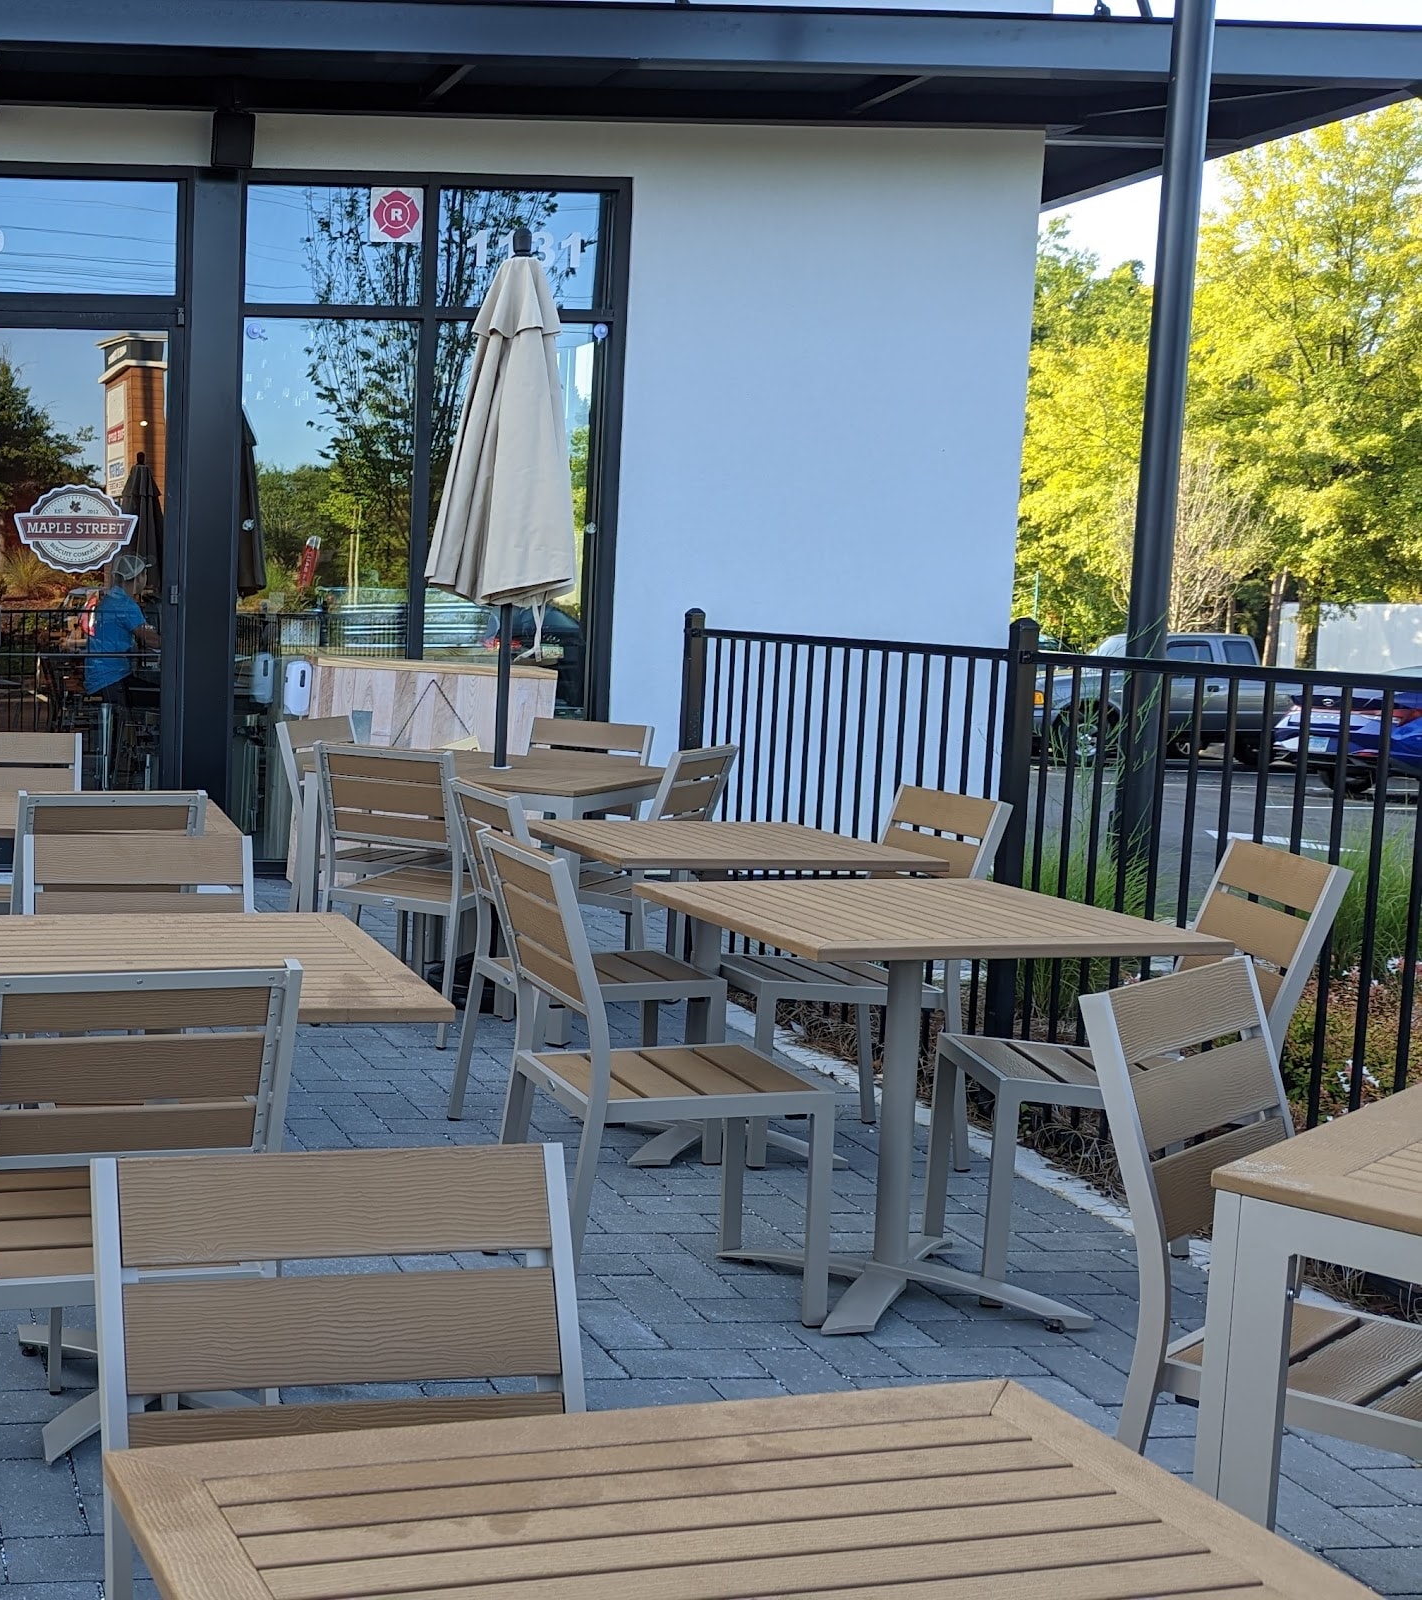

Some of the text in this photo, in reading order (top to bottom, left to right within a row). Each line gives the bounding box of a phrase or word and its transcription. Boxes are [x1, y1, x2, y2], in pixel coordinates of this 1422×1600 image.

[390, 208, 403, 222] R
[467, 229, 582, 268] 1131
[26, 522, 125, 535] MAPLE STREET
[50, 542, 101, 557] BISCUIT COMPANY
